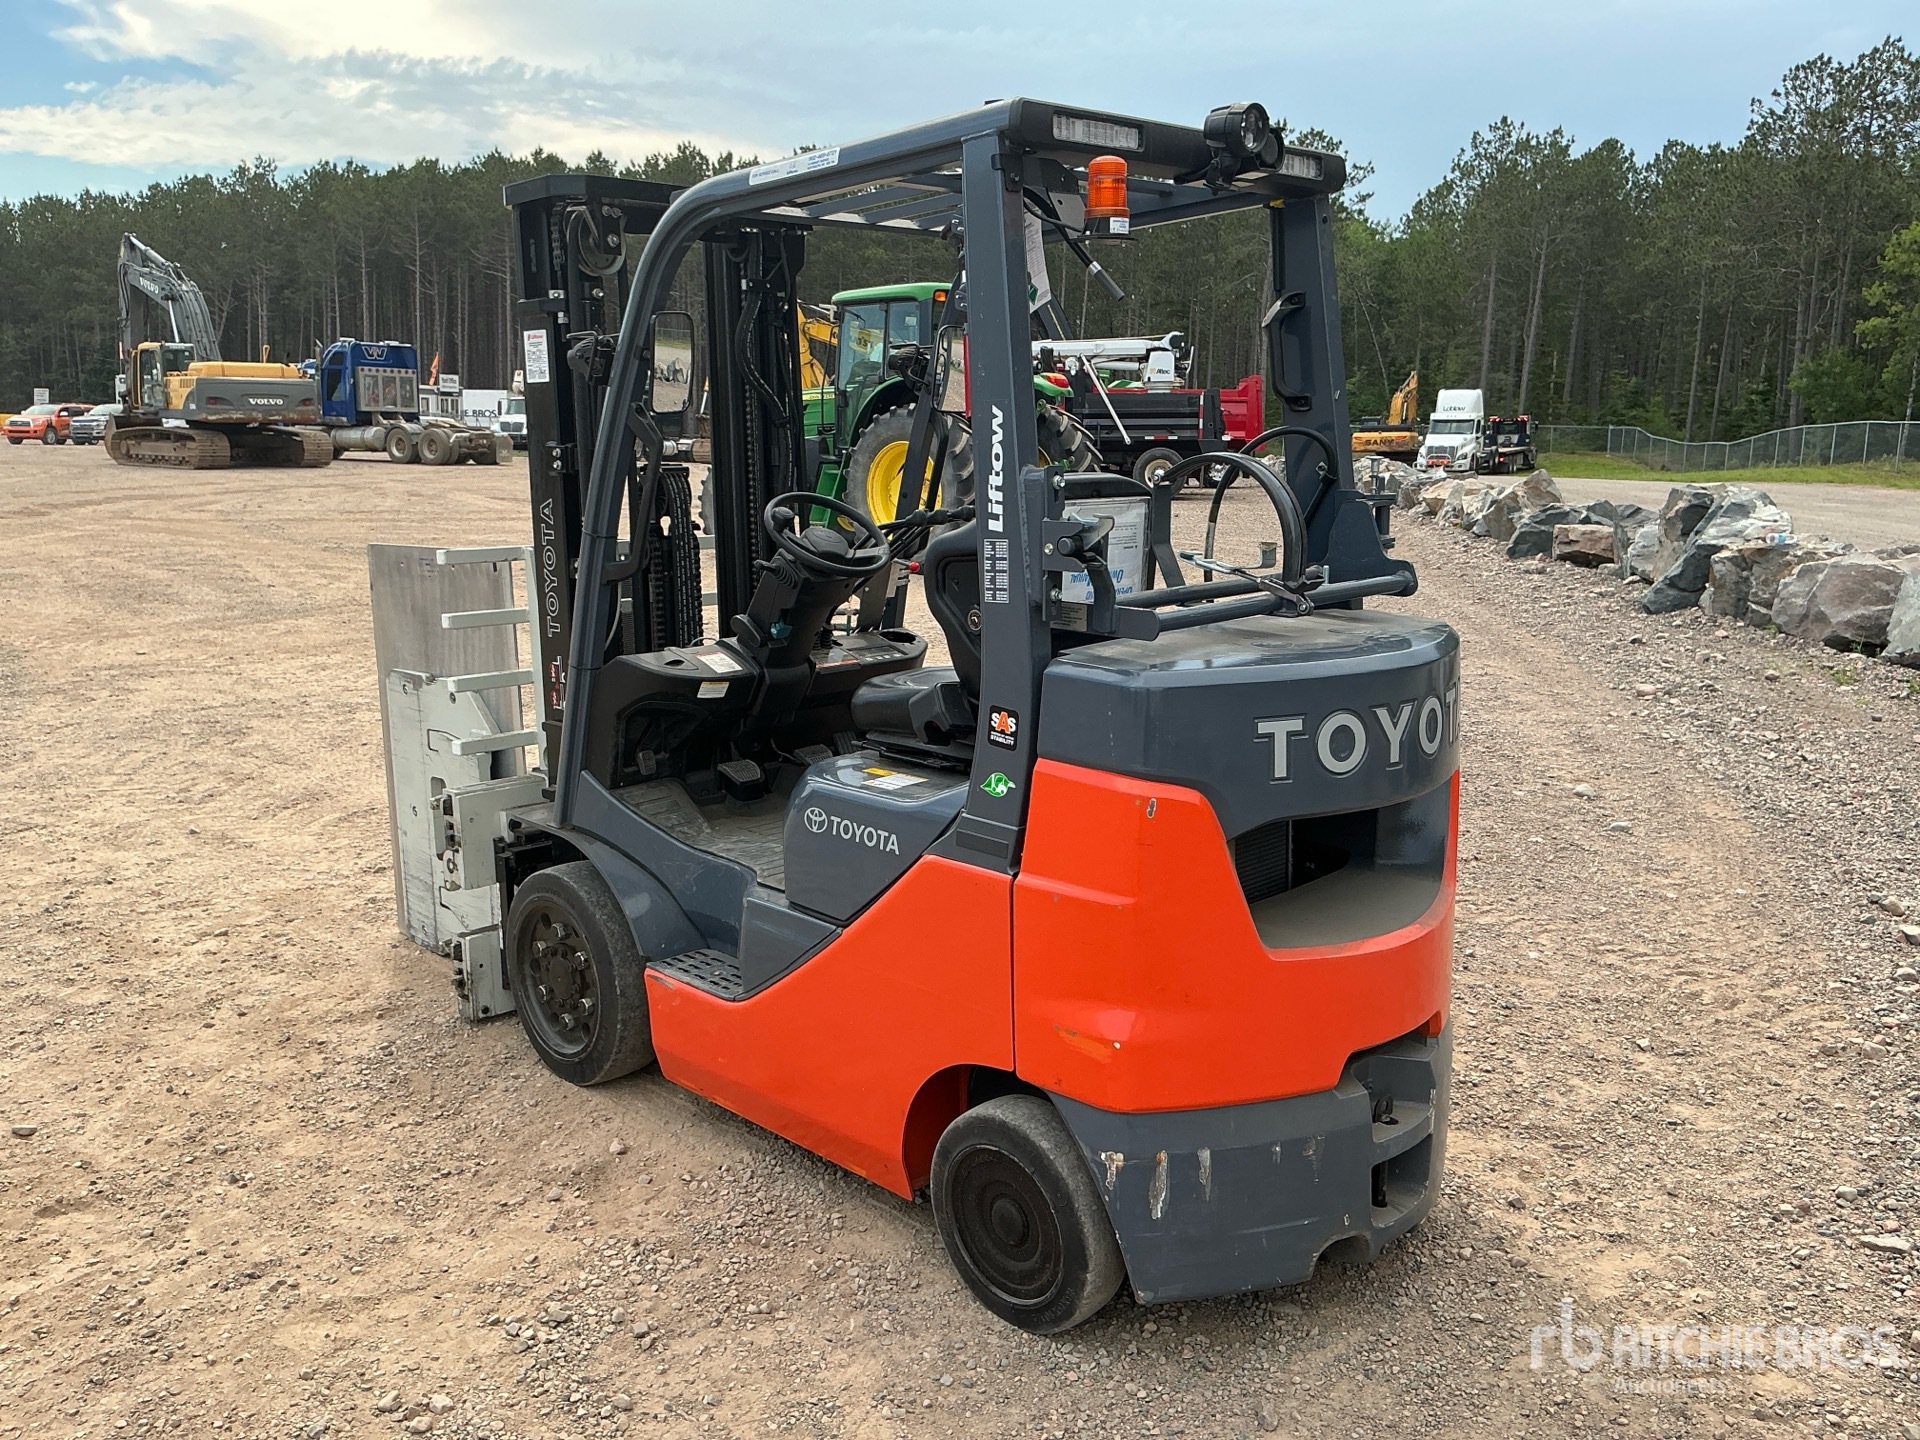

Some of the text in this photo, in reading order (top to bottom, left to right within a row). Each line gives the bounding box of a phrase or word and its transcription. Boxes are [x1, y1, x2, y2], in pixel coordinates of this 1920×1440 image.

[139, 277, 159, 294] VOLVO
[248, 398, 284, 406] VOLVO
[987, 404, 1004, 533] Liftow
[539, 498, 561, 637] TOYOTA
[990, 711, 1017, 734] SAS
[1256, 686, 1458, 779] TOYOT
[830, 815, 900, 856] TOYOTA
